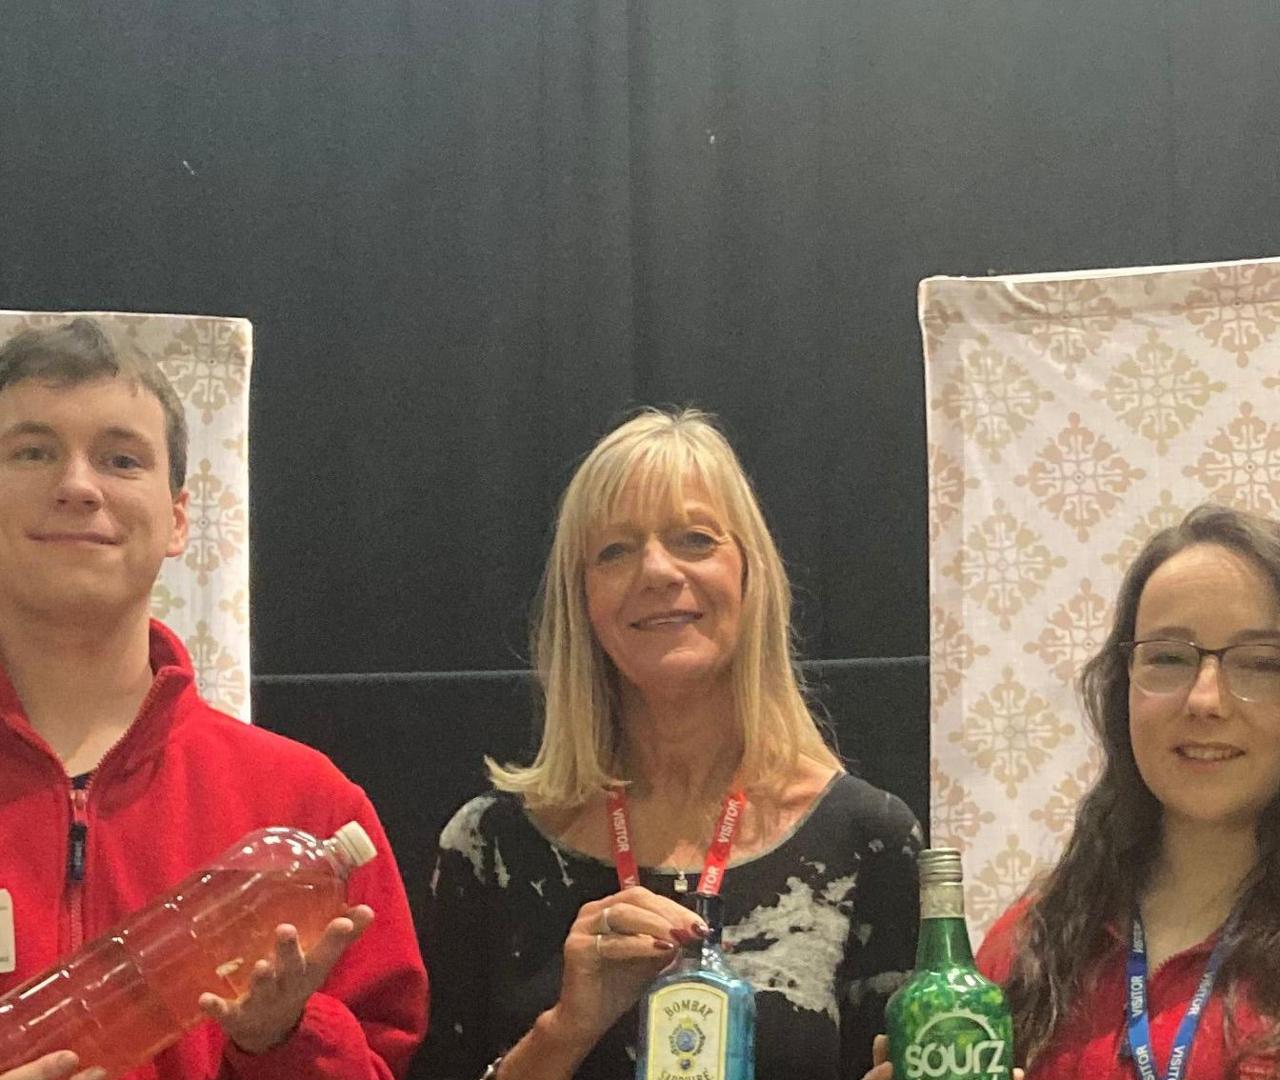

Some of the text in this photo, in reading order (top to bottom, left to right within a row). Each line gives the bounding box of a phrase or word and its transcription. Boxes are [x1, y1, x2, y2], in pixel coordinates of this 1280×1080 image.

[613, 808, 630, 852] VISITOR
[717, 799, 740, 843] VISITOR
[663, 1000, 714, 1019] BOMBAY
[1131, 975, 1143, 1018] VISITOR
